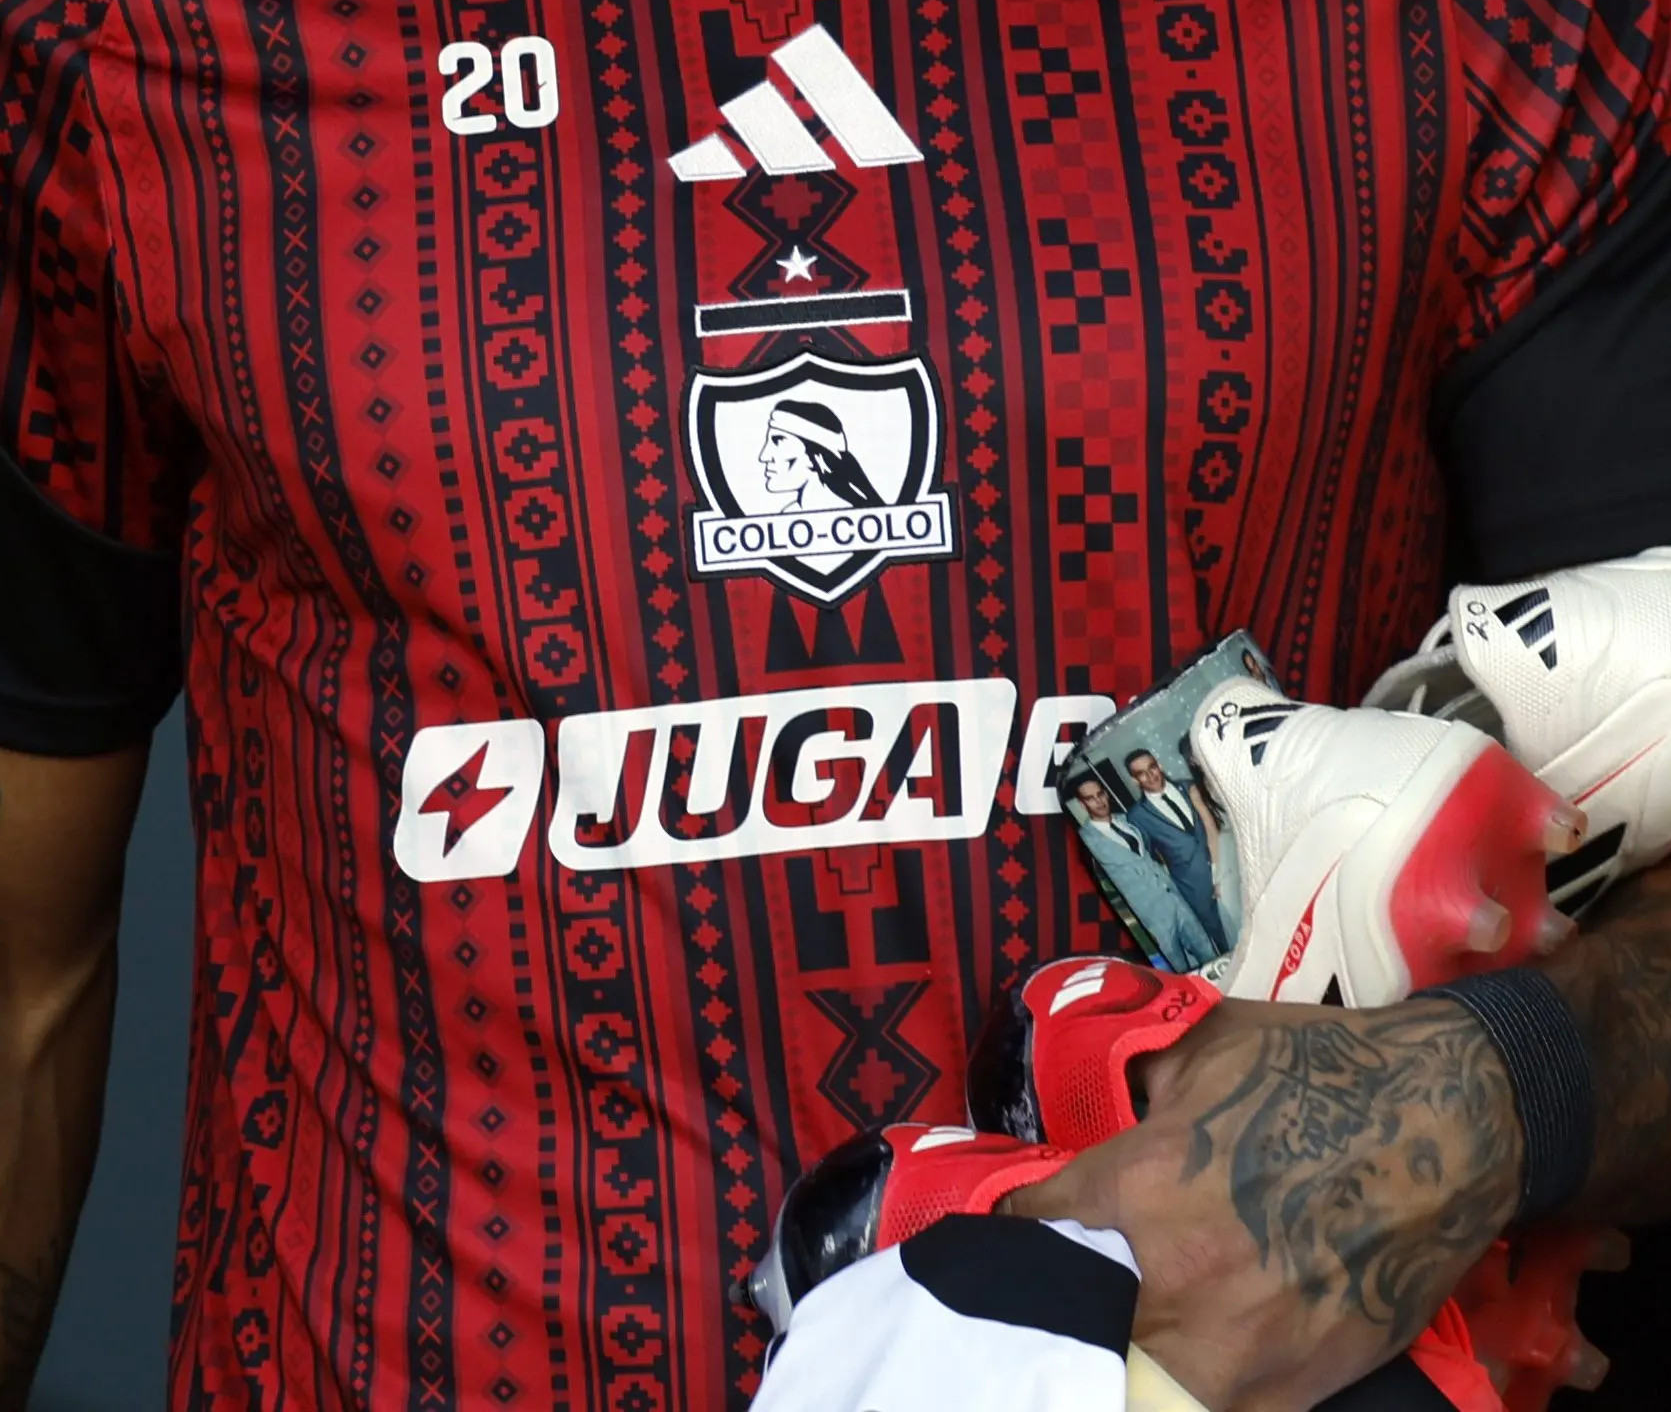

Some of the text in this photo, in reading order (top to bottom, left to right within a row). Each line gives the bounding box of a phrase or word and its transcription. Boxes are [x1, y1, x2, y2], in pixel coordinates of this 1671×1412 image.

[438, 35, 559, 135] 20
[712, 510, 932, 555] COLO-COLO
[1466, 600, 1489, 642] 20
[1204, 701, 1239, 741] 20
[1284, 922, 1311, 973] COPA
